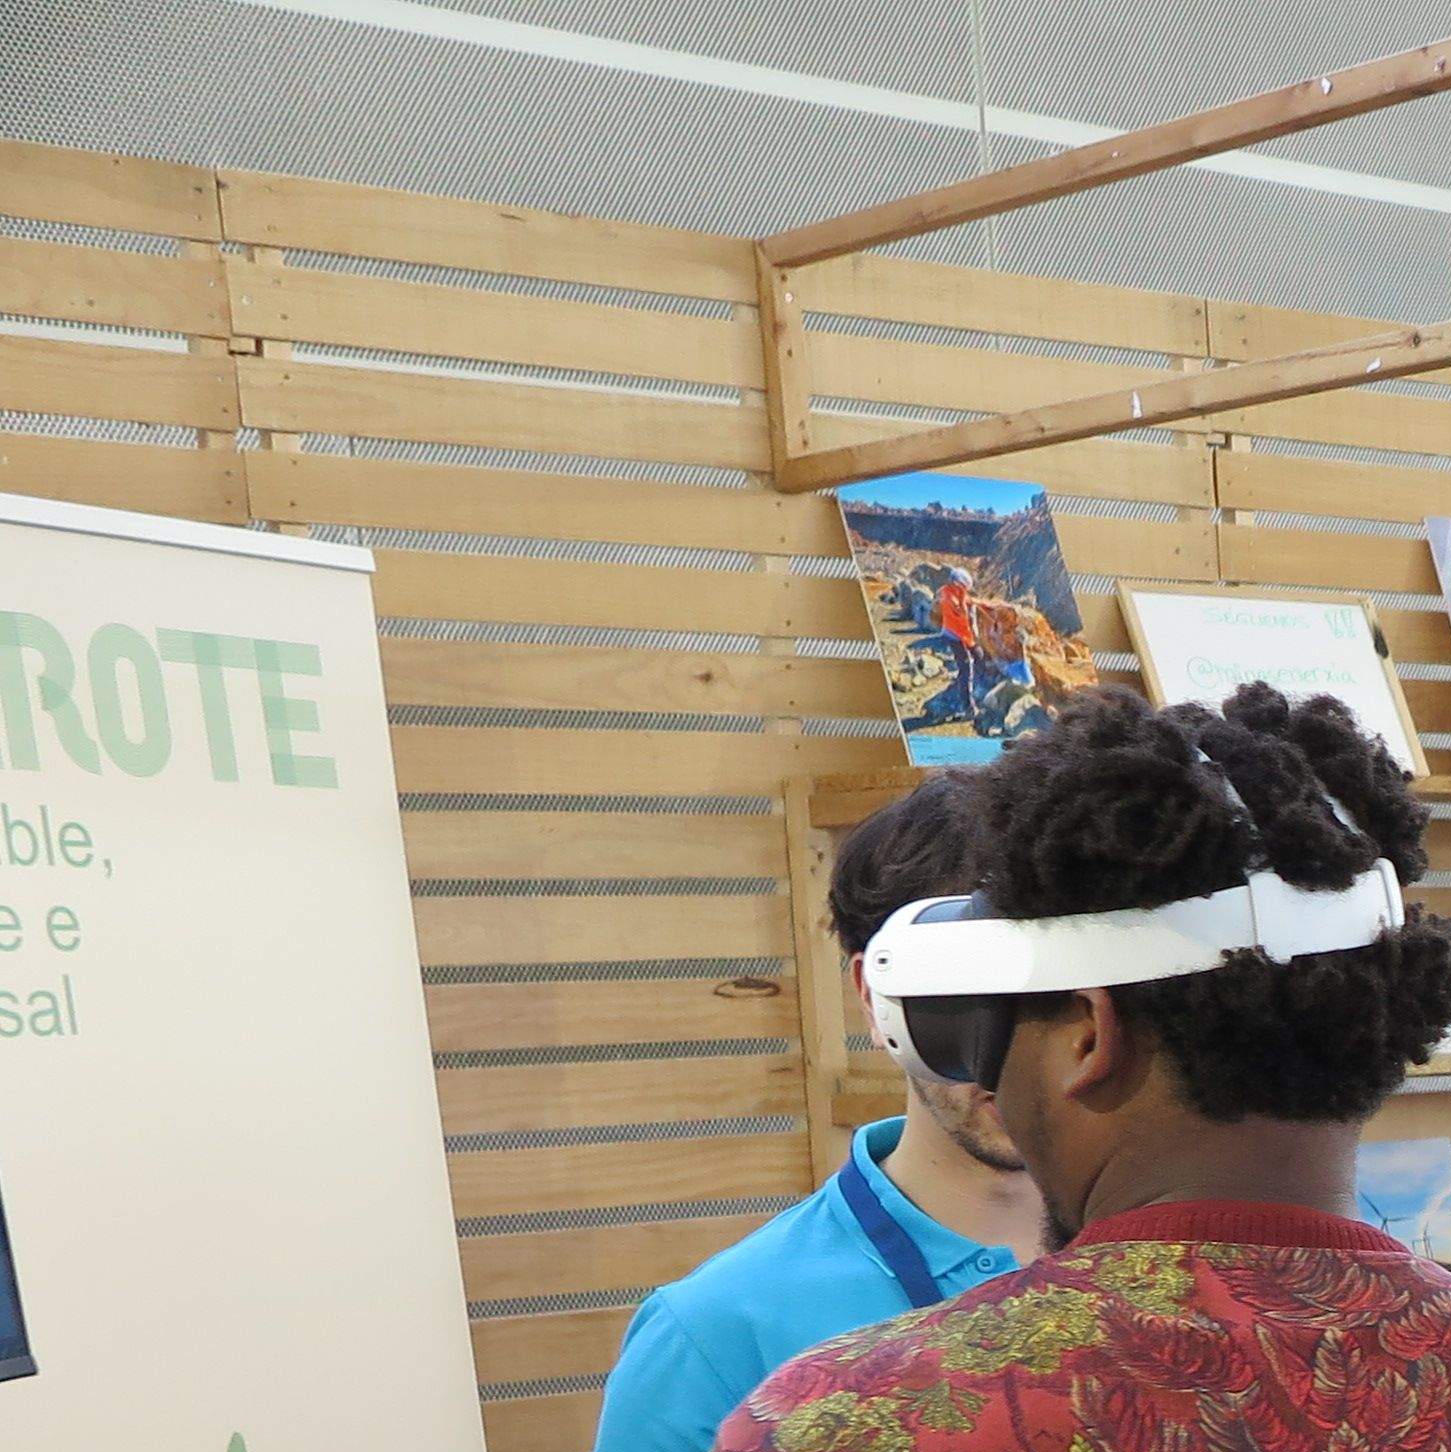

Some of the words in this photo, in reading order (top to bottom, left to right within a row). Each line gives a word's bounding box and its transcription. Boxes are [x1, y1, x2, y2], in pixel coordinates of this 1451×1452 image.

[0, 610, 340, 790] ROTE
[0, 804, 113, 878] ble,
[46, 905, 82, 953] e
